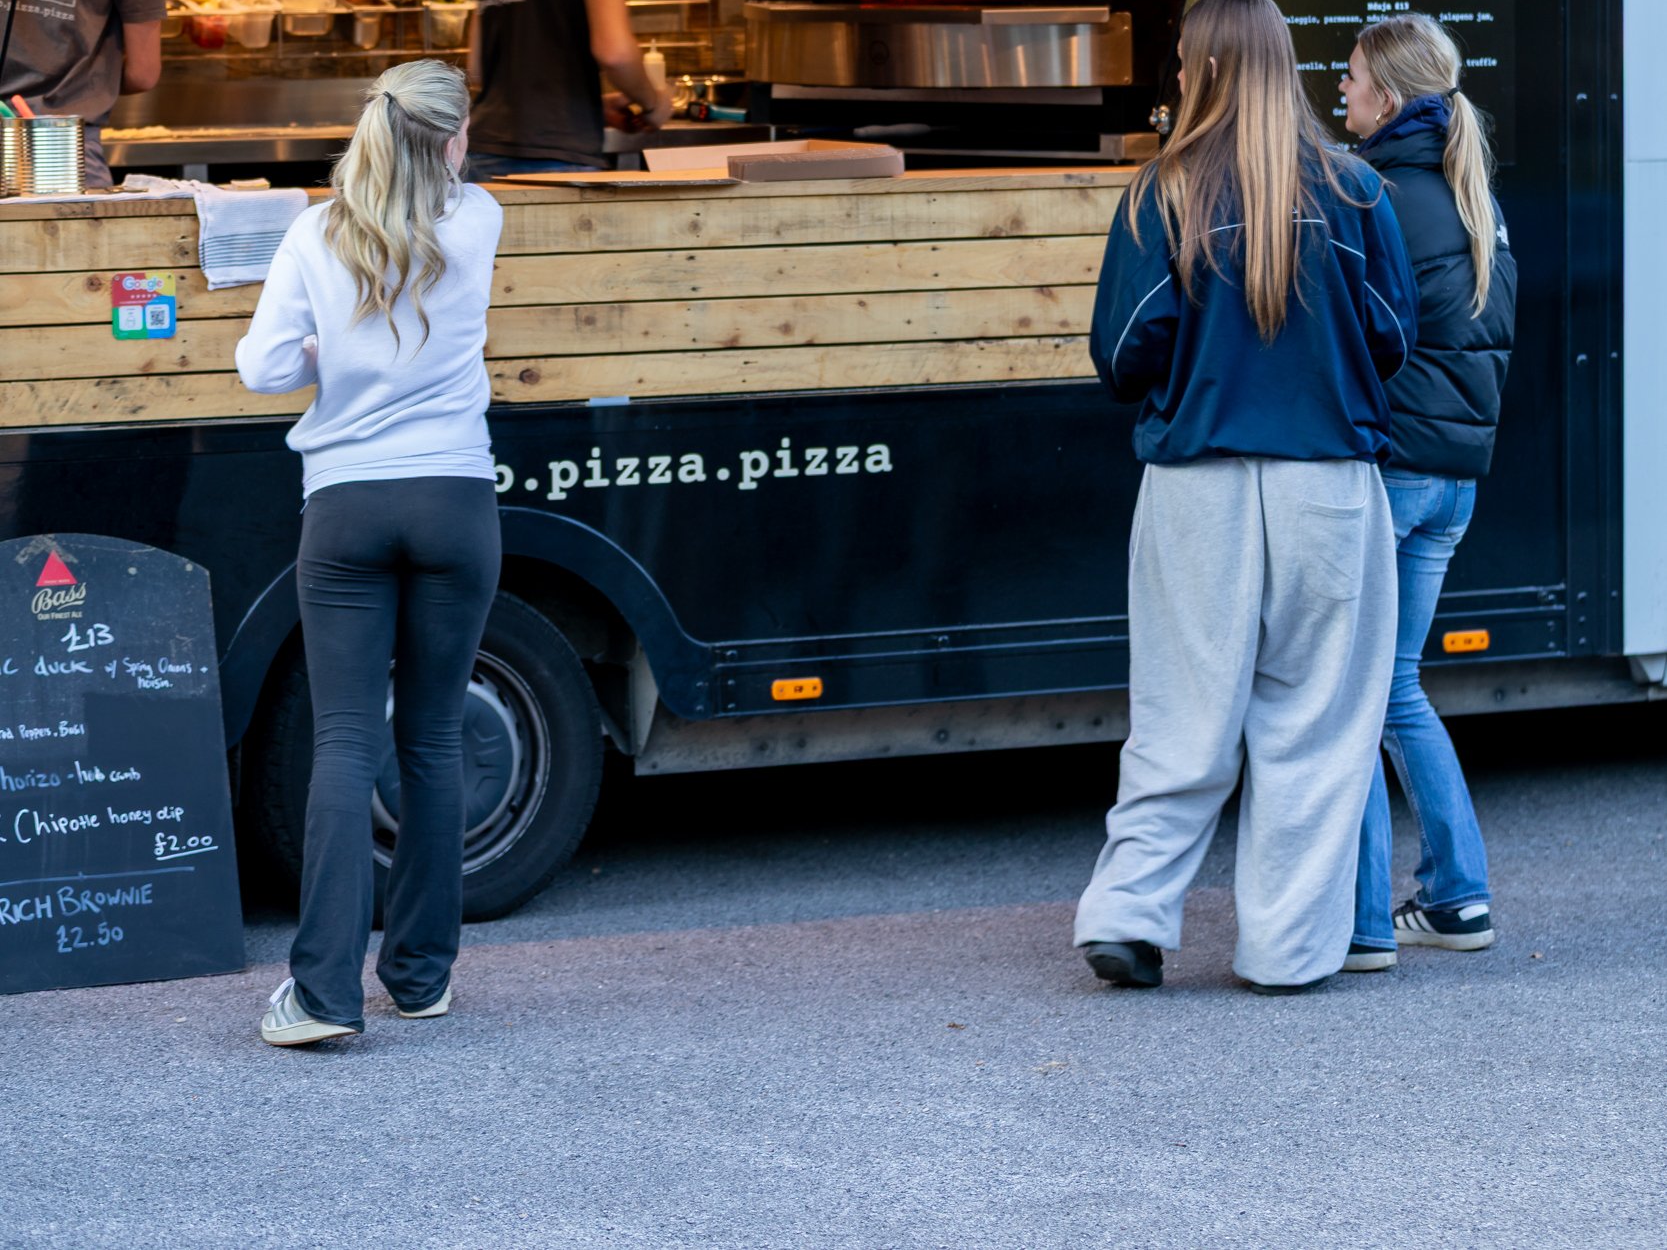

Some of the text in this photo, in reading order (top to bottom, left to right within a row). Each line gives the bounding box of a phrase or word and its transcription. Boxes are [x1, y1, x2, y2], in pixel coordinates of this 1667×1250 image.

[1366, 2, 1391, 11] Nduja
[1467, 58, 1498, 68] truffle
[123, 277, 164, 291] Google
[31, 582, 86, 615] Bass
[60, 623, 115, 653] £13
[34, 655, 94, 677] duck
[0, 765, 61, 792] horizo
[14, 808, 100, 844] Chipotle
[107, 806, 152, 825] honey
[156, 805, 184, 823] dip
[153, 832, 213, 857] £2.00
[56, 882, 153, 917] BROWNIE
[56, 921, 124, 954] £2.50
